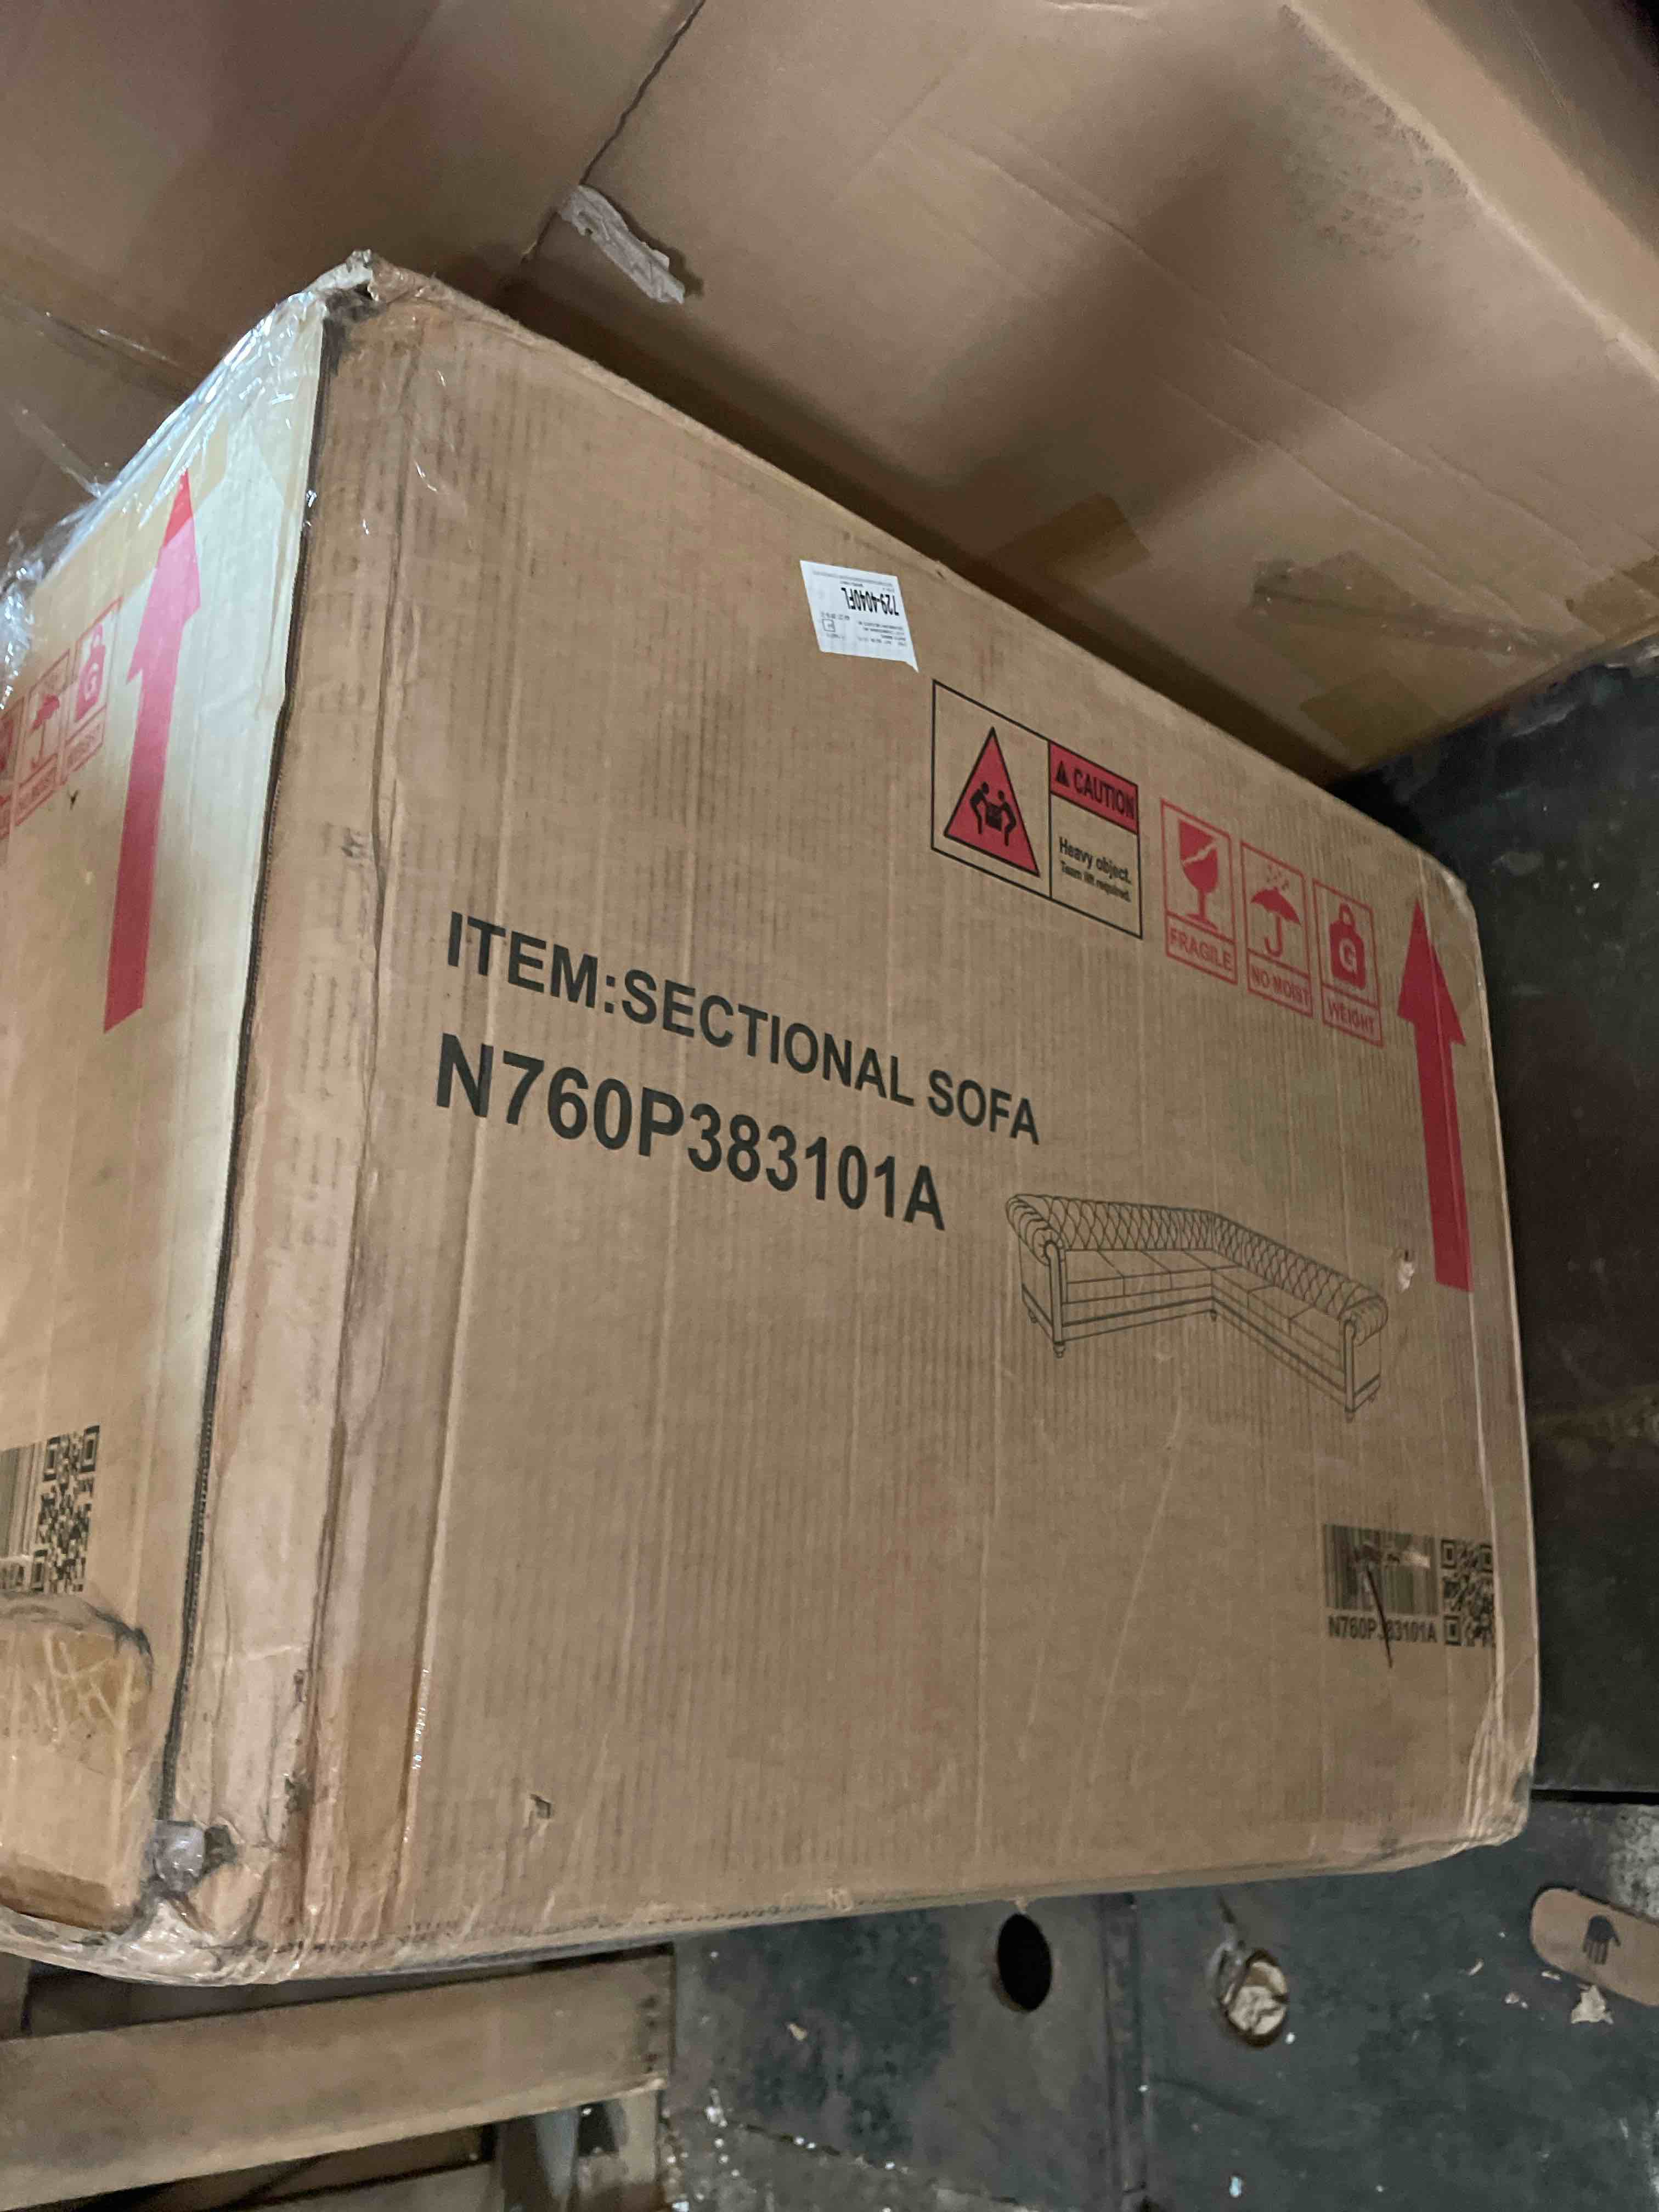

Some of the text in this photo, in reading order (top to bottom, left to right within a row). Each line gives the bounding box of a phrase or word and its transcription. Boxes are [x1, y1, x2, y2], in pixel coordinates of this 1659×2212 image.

[841, 587, 899, 616] 729-4040FL
[1073, 769, 1135, 820] CAUTION
[1059, 836, 1093, 869] Heavy
[1170, 928, 1233, 973] FRAGILE
[1251, 964, 1310, 1007] NO MOIST
[927, 1069, 1040, 1145] SOFA
[436, 1032, 945, 1231] N760P383101A
